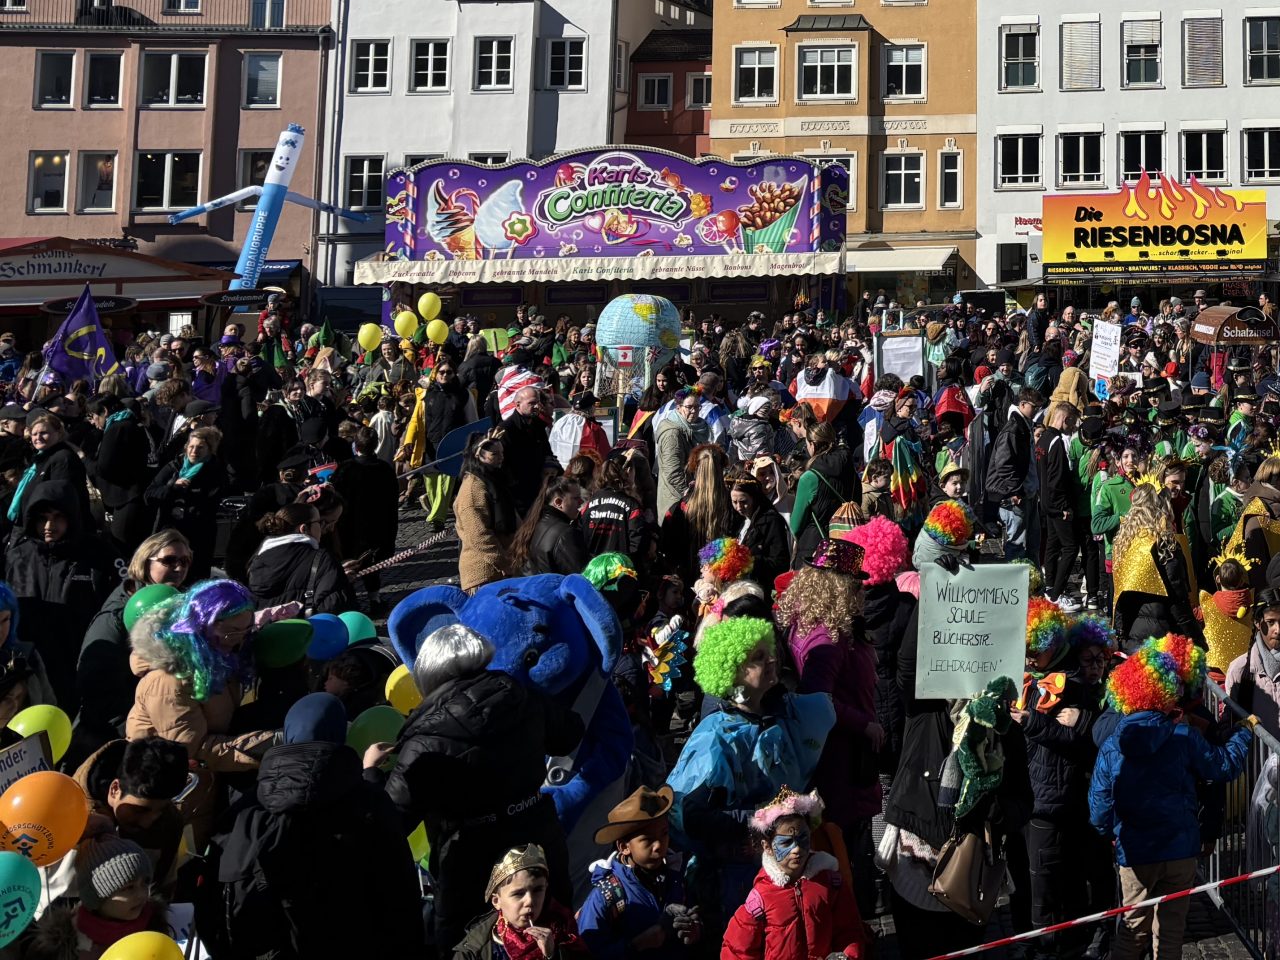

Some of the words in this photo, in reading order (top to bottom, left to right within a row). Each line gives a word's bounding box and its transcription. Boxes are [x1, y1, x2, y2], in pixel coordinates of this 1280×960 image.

[587, 165, 651, 186] Karls
[548, 184, 683, 222] Confiteria
[1074, 206, 1103, 222] Die
[1074, 223, 1245, 248] RIESENBOSNA
[0, 259, 107, 279] Schmankerl
[392, 270, 436, 278] Zuckerwatte
[449, 270, 476, 278] Popcorn
[492, 269, 526, 277] gebrannte
[528, 268, 558, 276] Mandeln
[573, 267, 593, 275] Karls
[596, 266, 634, 275] Confiteria
[651, 266, 684, 274] gebrannte
[685, 264, 706, 272] Nüsse
[724, 263, 752, 271] Bonbons
[770, 262, 806, 270] Magenbrot
[915, 267, 954, 276] WEBER
[1223, 326, 1274, 338] Schatzinsel
[946, 607, 989, 624] SCHULE
[507, 796, 537, 816] Calvin
